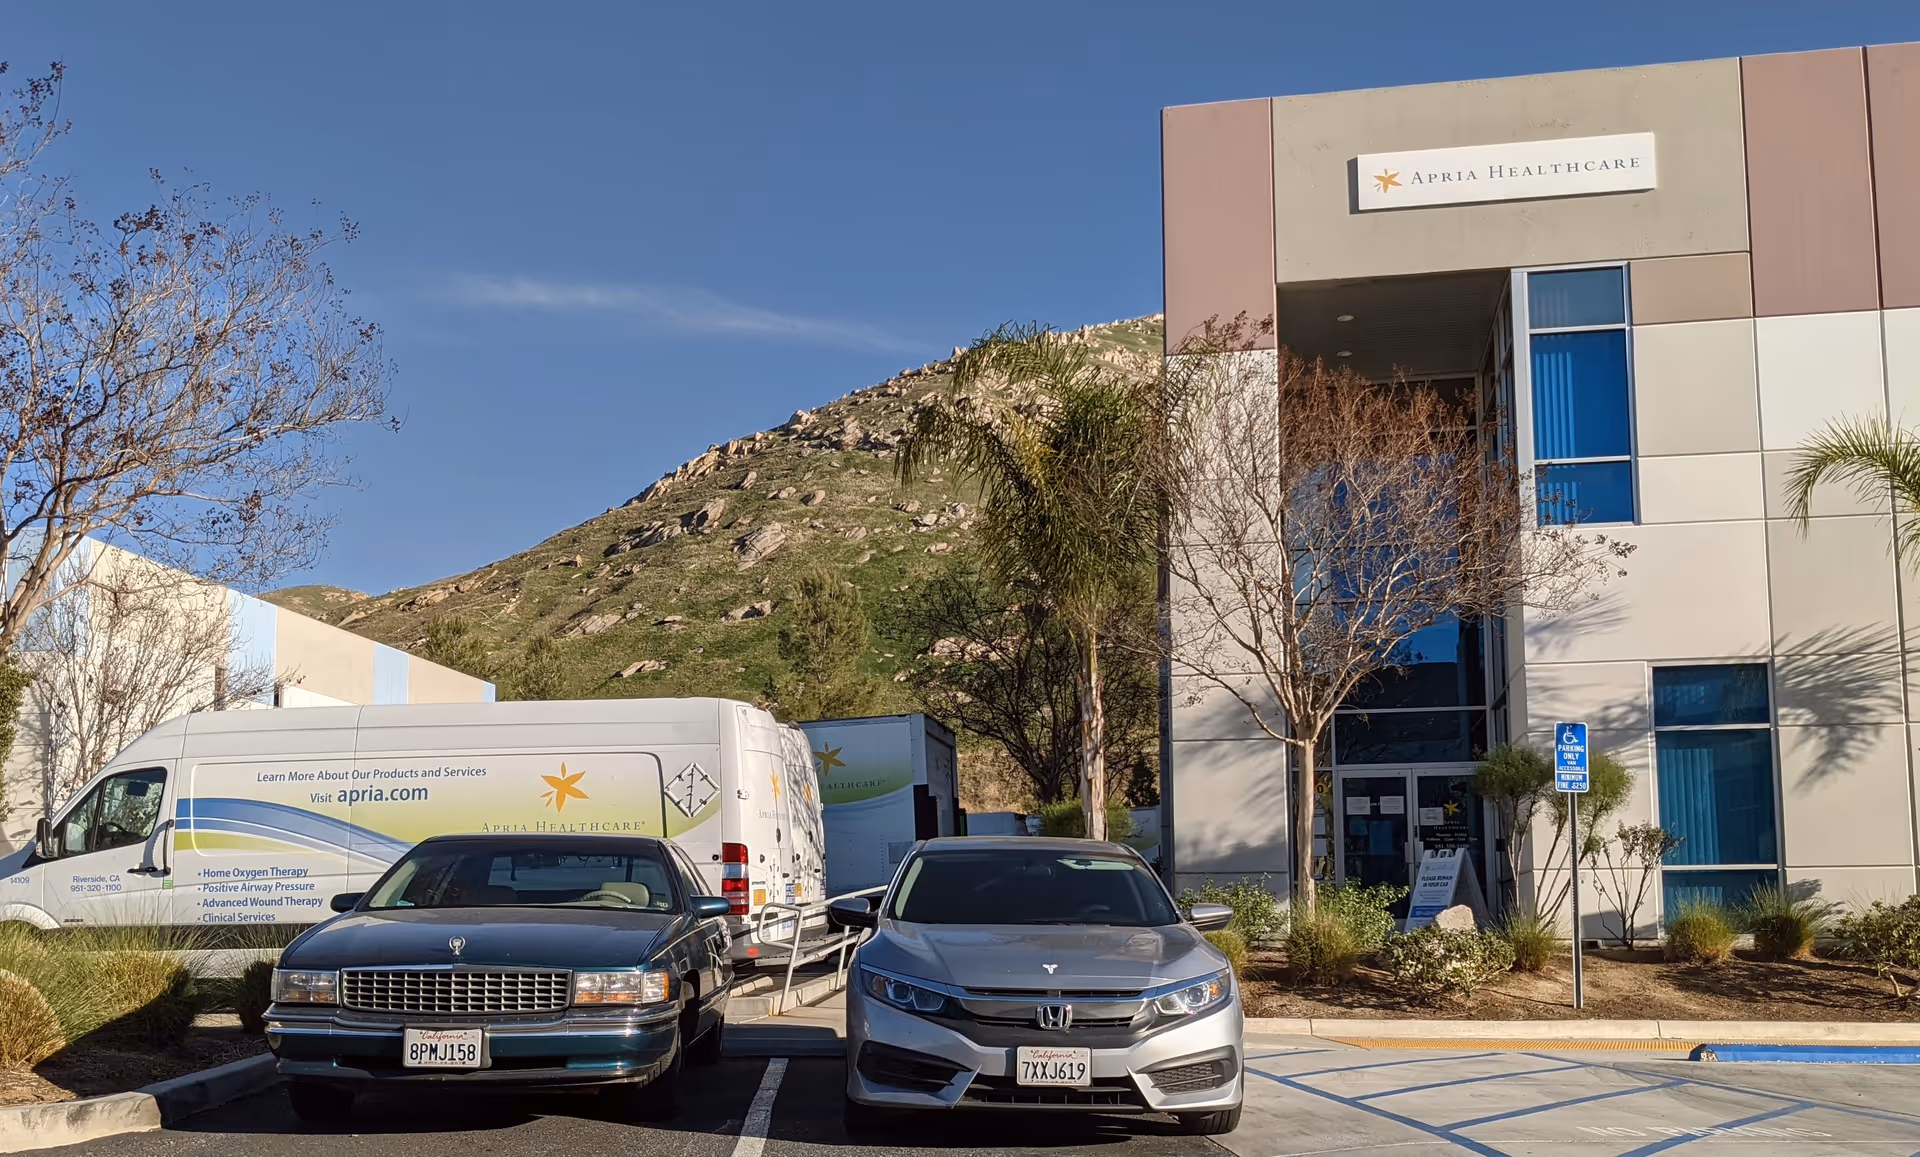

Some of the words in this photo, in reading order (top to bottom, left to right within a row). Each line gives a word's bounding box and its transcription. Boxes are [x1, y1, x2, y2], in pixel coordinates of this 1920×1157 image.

[1411, 170, 1478, 185] APRIA
[1489, 156, 1641, 179] HEALTHCARE
[1557, 744, 1585, 753] PARKING
[1563, 752, 1580, 760] ONLY
[257, 771, 286, 782] Learn
[288, 771, 315, 781] More
[317, 770, 349, 780] About
[351, 769, 371, 780] Our
[373, 768, 419, 779] Products
[421, 766, 441, 777] and
[443, 766, 487, 777] Services
[1557, 781, 1569, 789] FINE
[1571, 782, 1587, 790] $250
[310, 792, 332, 803] Visit
[337, 785, 428, 806] apria.com
[481, 822, 527, 832] APRIA
[72, 875, 108, 884] Riverside,
[109, 874, 121, 882] CA
[203, 868, 231, 878] Home
[232, 868, 269, 879] Oxygen
[270, 867, 309, 878] Therapy
[10, 876, 30, 885] 14109
[203, 883, 239, 893] Positive
[240, 882, 273, 893] Airway
[274, 882, 315, 891] Pressure
[202, 898, 248, 908] Advanced
[249, 897, 283, 906] Wound
[284, 896, 323, 908] Therapy
[202, 912, 236, 923] Clinical
[238, 911, 276, 922] Services
[421, 1030, 466, 1042] California
[410, 1042, 476, 1061] 8PMJ158
[1032, 1049, 1076, 1061] California
[1022, 1061, 1086, 1080] 7XXJ619
